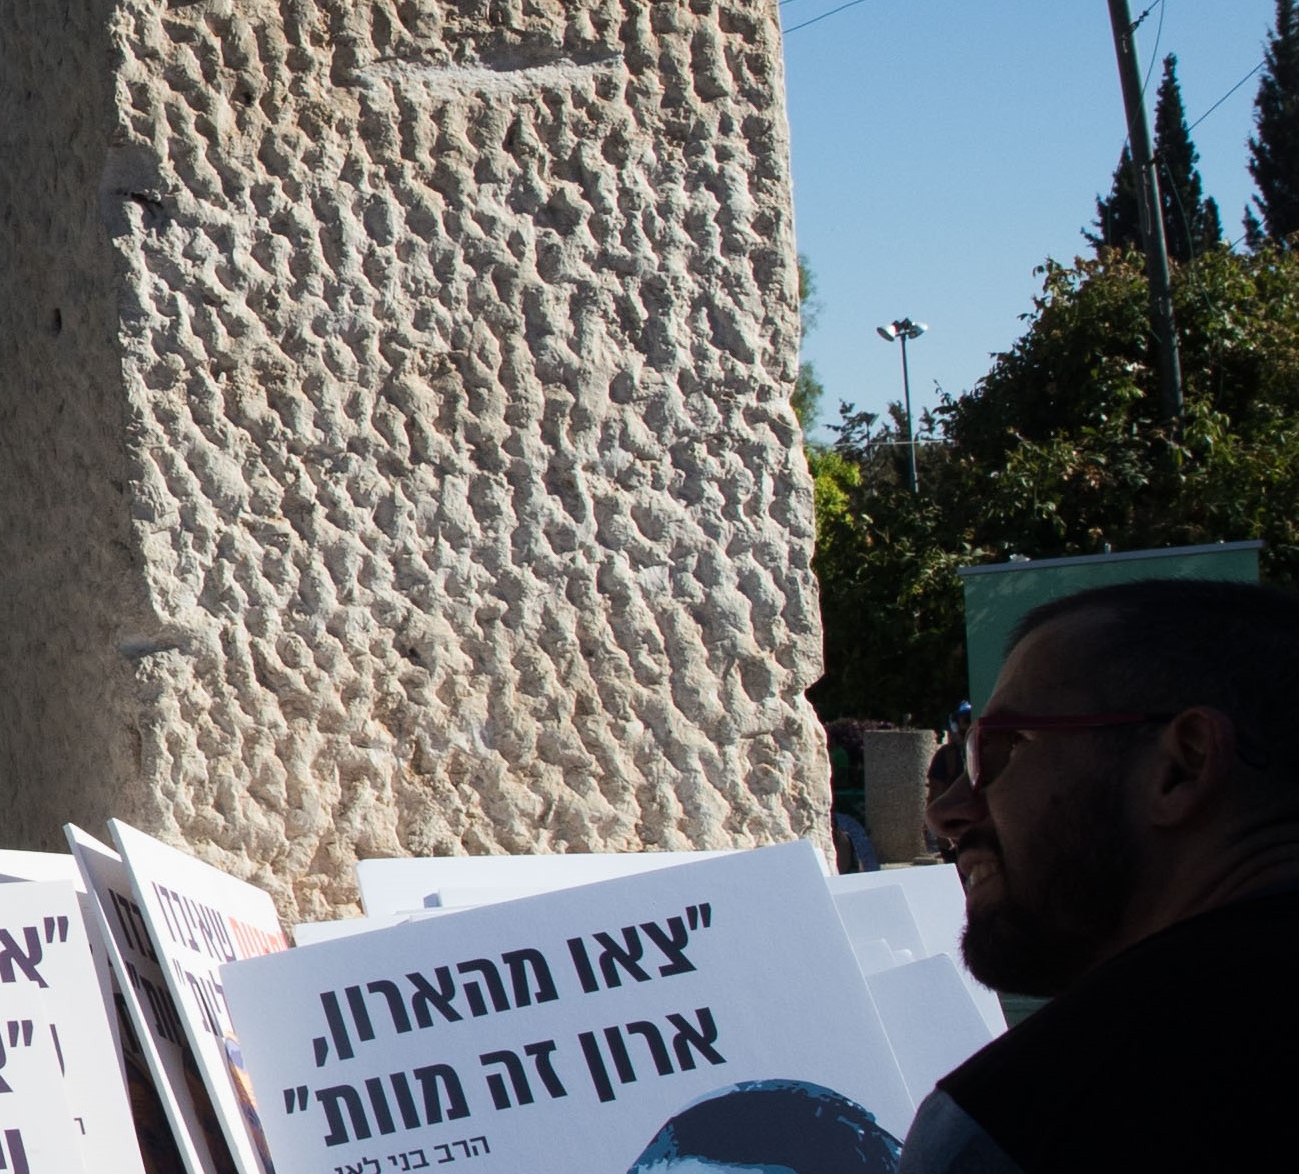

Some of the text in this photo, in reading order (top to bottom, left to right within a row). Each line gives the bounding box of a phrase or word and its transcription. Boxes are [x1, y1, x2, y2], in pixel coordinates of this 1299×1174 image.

[312, 902, 713, 1067] "צאו מהארון,
[283, 1006, 727, 1147] ארון זה מוות"
[387, 1148, 430, 1172] בני
[434, 1135, 491, 1164] הרב
